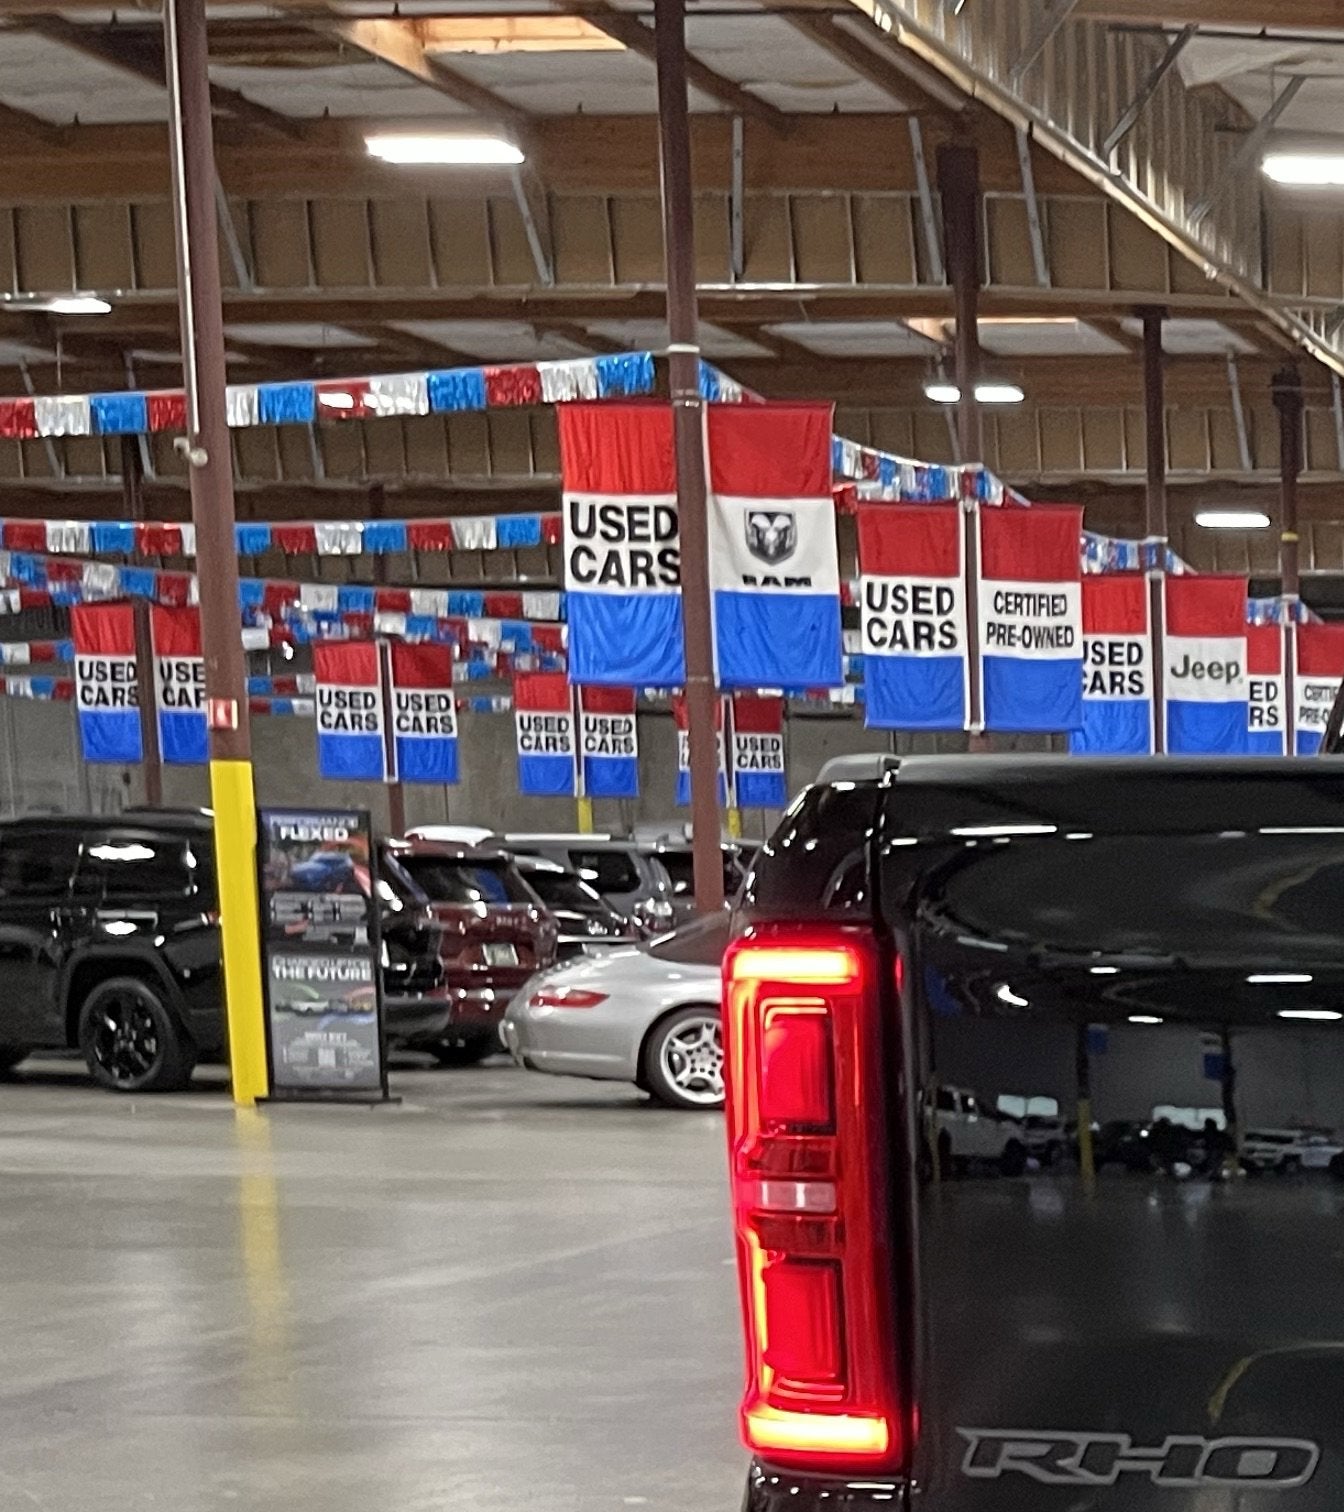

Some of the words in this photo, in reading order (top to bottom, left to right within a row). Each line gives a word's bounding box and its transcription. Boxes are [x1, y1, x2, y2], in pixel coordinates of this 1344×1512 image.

[570, 502, 678, 543] USED
[570, 545, 681, 588] CARS
[867, 582, 955, 616] USED
[993, 590, 1068, 618] CERTIFIED
[867, 617, 958, 651] CARS
[986, 621, 1076, 649] PRE-OWNED
[79, 661, 136, 683] USED
[160, 662, 205, 684] USE
[1171, 655, 1240, 684] Jeep
[1083, 670, 1144, 695] ARS
[80, 685, 138, 706] CARS
[319, 689, 376, 710] USED
[396, 693, 450, 713] USED
[320, 711, 378, 732] CARS
[396, 714, 453, 734] CARS
[520, 715, 569, 733] USED
[585, 716, 632, 735] USED
[520, 735, 571, 752] CARS
[585, 735, 634, 754] CARS
[736, 736, 780, 752] USED
[737, 753, 781, 769] CARS
[956, 1427, 1320, 1486] RHO
